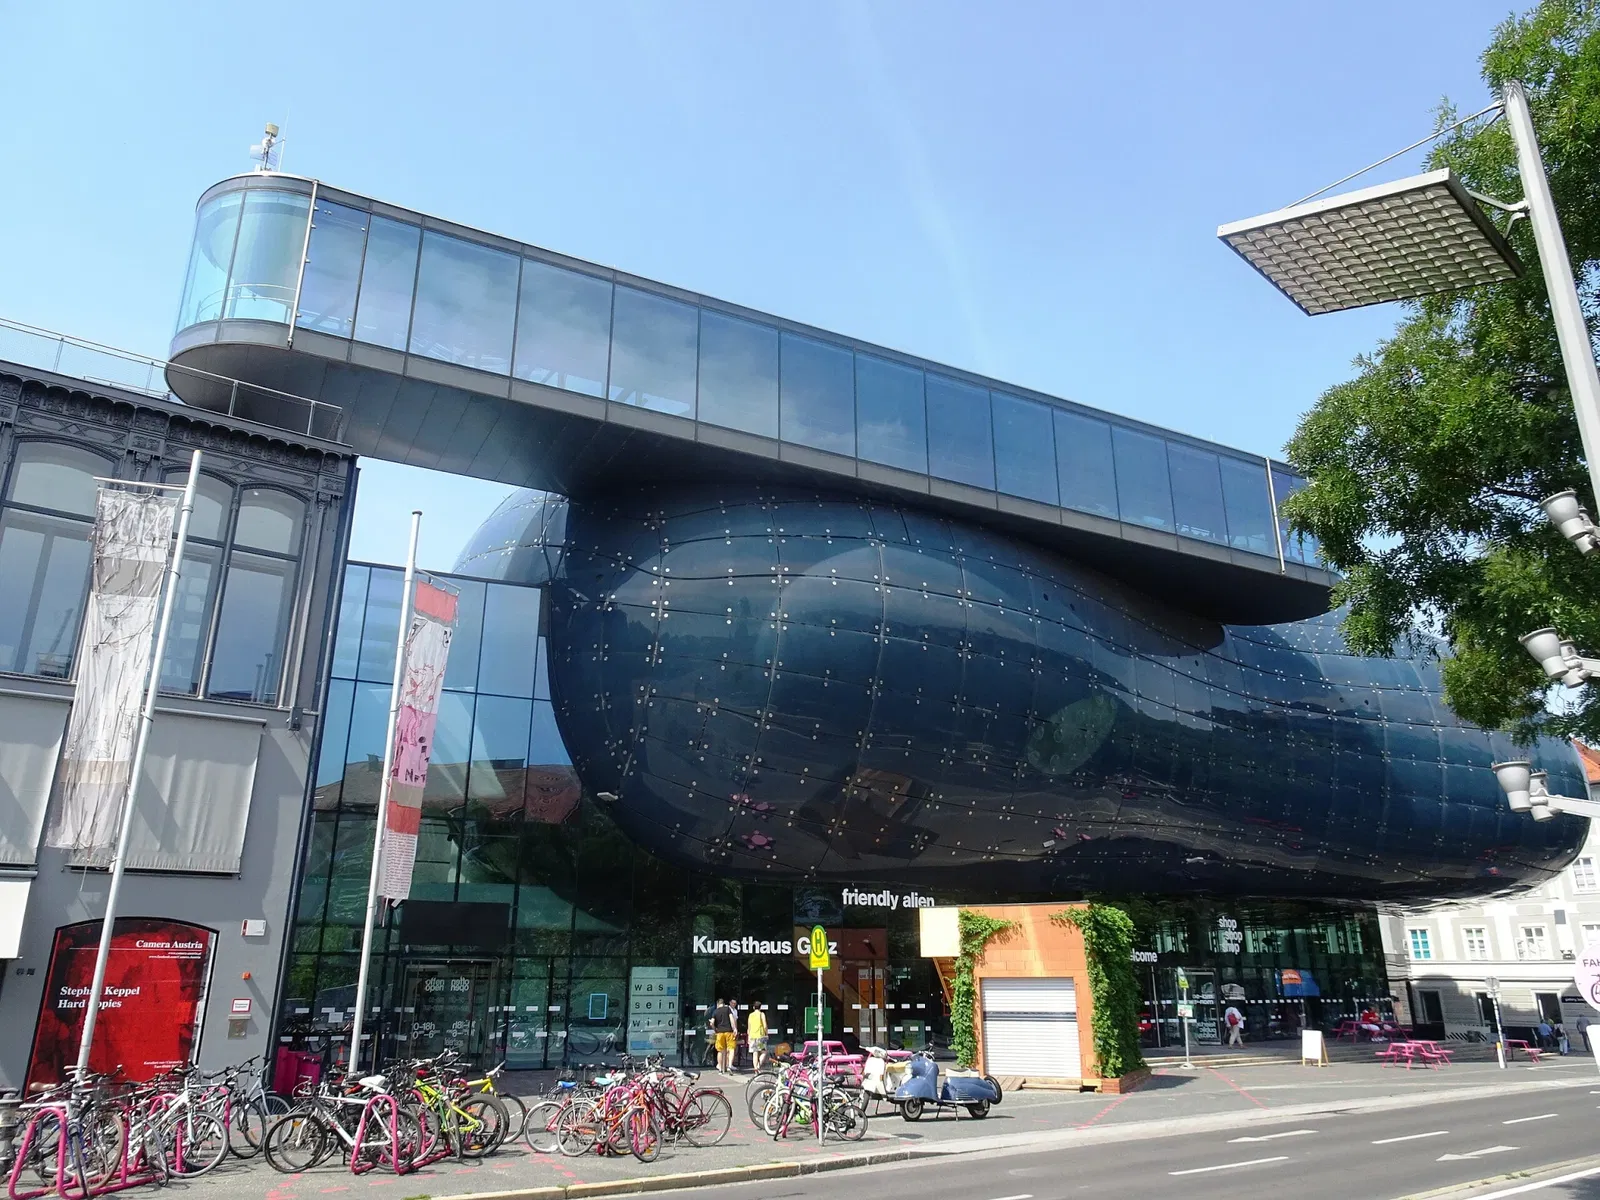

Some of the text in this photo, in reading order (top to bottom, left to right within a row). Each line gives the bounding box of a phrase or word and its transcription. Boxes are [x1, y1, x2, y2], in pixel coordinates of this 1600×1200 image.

[842, 888, 935, 910] friendly alien
[1219, 915, 1237, 931] shop
[135, 939, 203, 949] Camera Austria
[693, 935, 837, 954] Kunsthaus Gz
[1130, 948, 1158, 962] lcome
[60, 986, 140, 997] Steph Keppel
[634, 983, 664, 992] was
[57, 999, 86, 1009] Hard
[634, 999, 675, 1010] sein
[632, 1017, 674, 1028] wird
